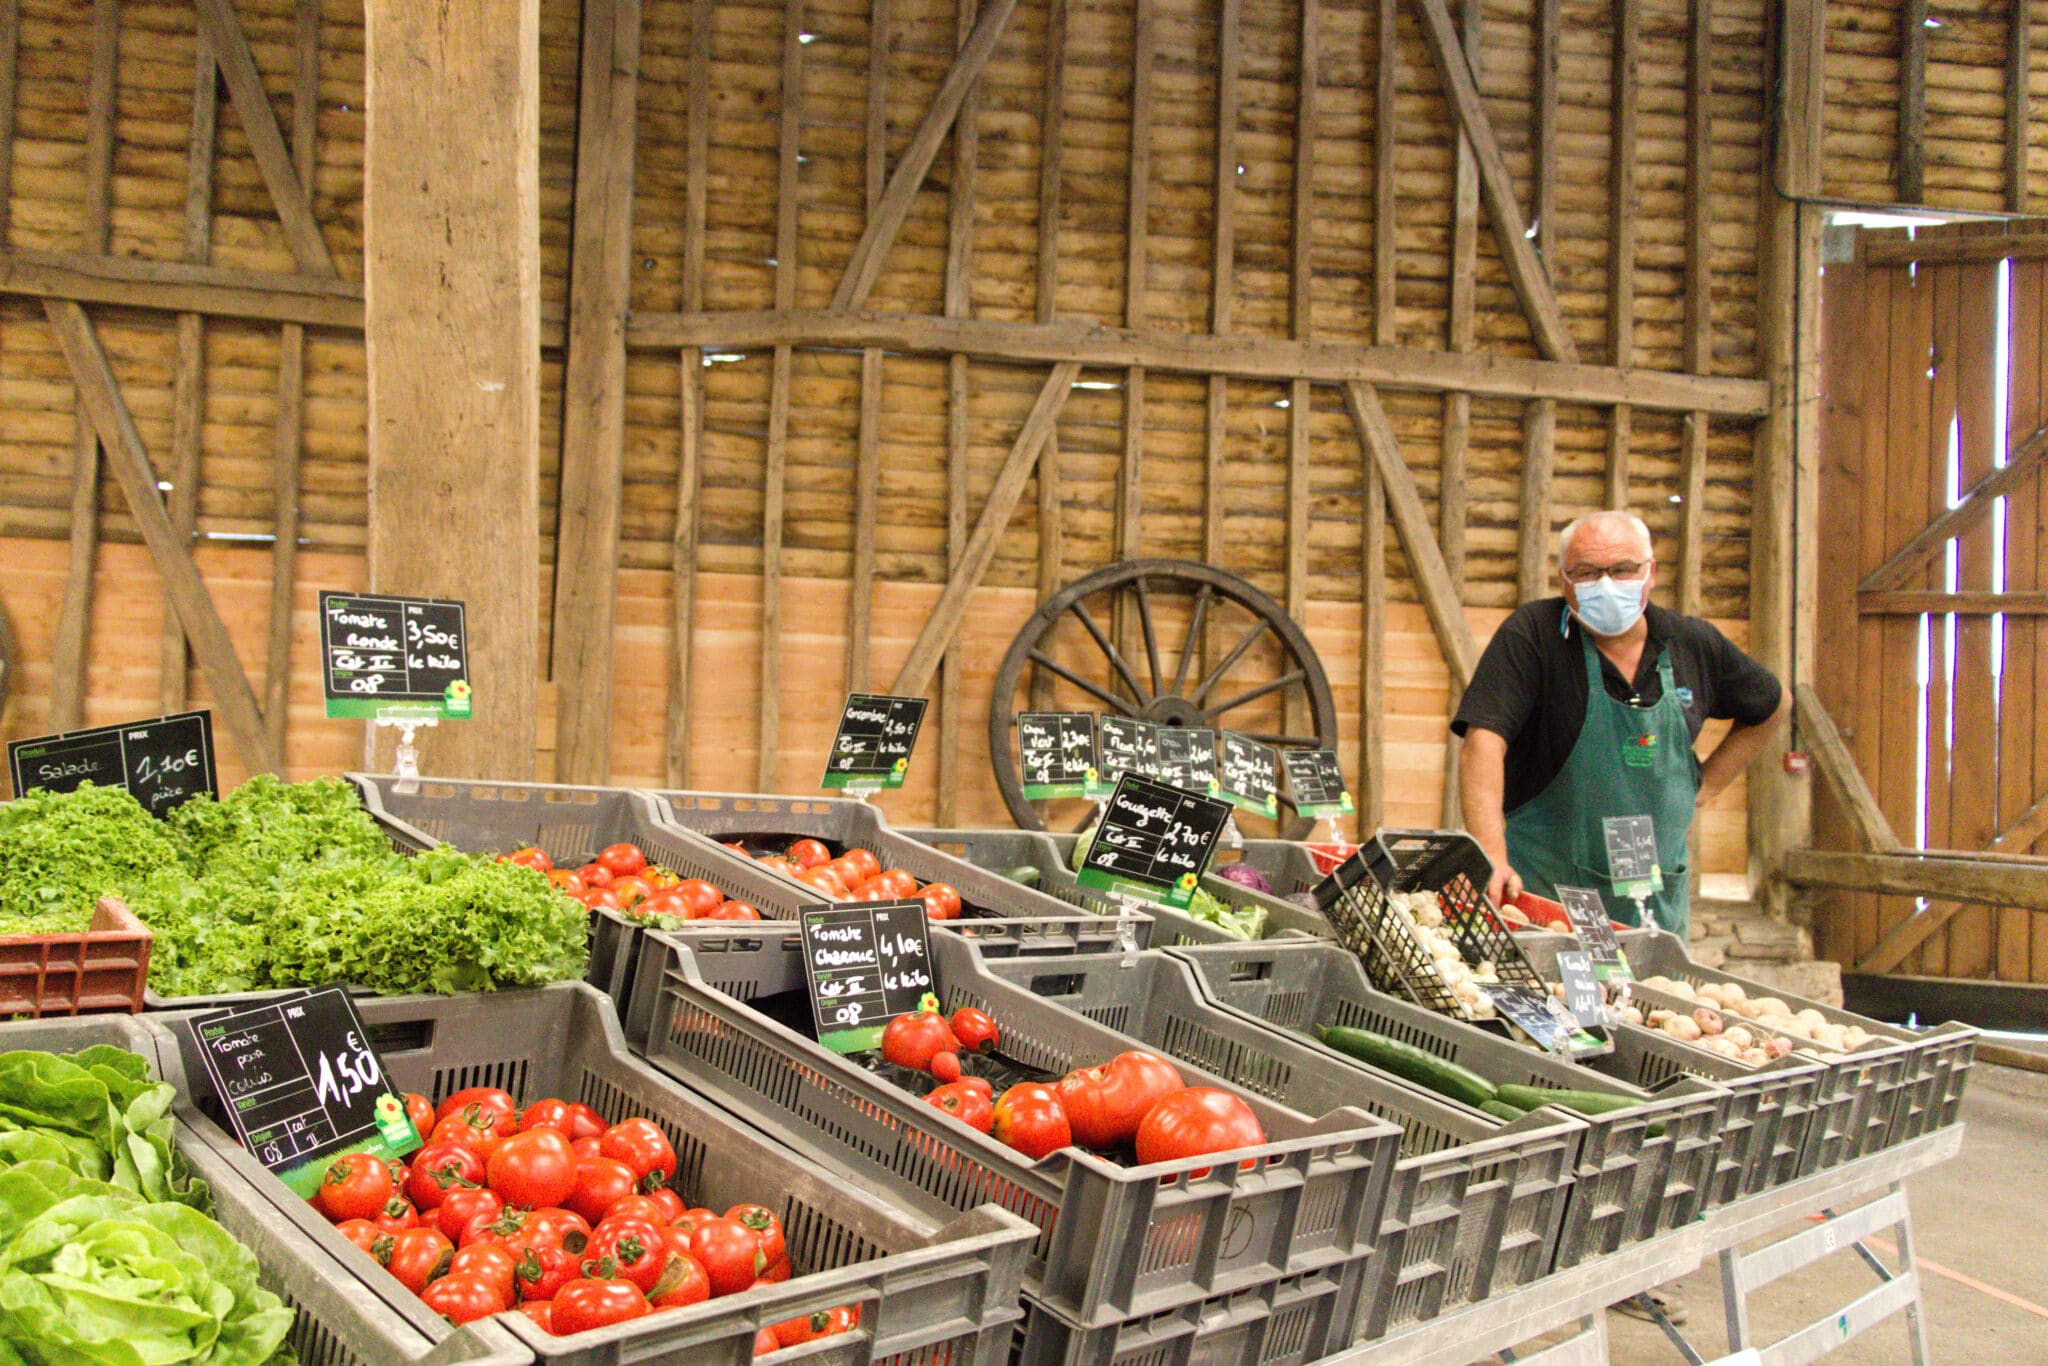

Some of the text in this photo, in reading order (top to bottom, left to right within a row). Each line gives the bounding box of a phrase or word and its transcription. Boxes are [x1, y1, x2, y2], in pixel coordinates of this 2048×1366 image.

[328, 609, 388, 629] Tomate
[347, 633, 399, 651] Ronde
[407, 620, 458, 650] 3,50€
[407, 654, 461, 670] le kilo
[350, 674, 385, 693] 08
[128, 730, 149, 741] PRIX
[39, 758, 104, 781] Salade
[135, 749, 199, 785] 1,10€
[1116, 794, 1173, 827] Courgette
[1097, 852, 1119, 867] 08
[1170, 852, 1196, 868] kilo
[809, 924, 862, 941] Tomate
[881, 932, 924, 968] 4,10€
[883, 969, 929, 990] le kilo
[286, 1007, 305, 1019] PRIX
[836, 1002, 863, 1025] 08
[212, 1031, 258, 1053] Tomate
[236, 1049, 266, 1069] pour
[318, 1050, 380, 1108] 1,50
[264, 1141, 283, 1163] 08
